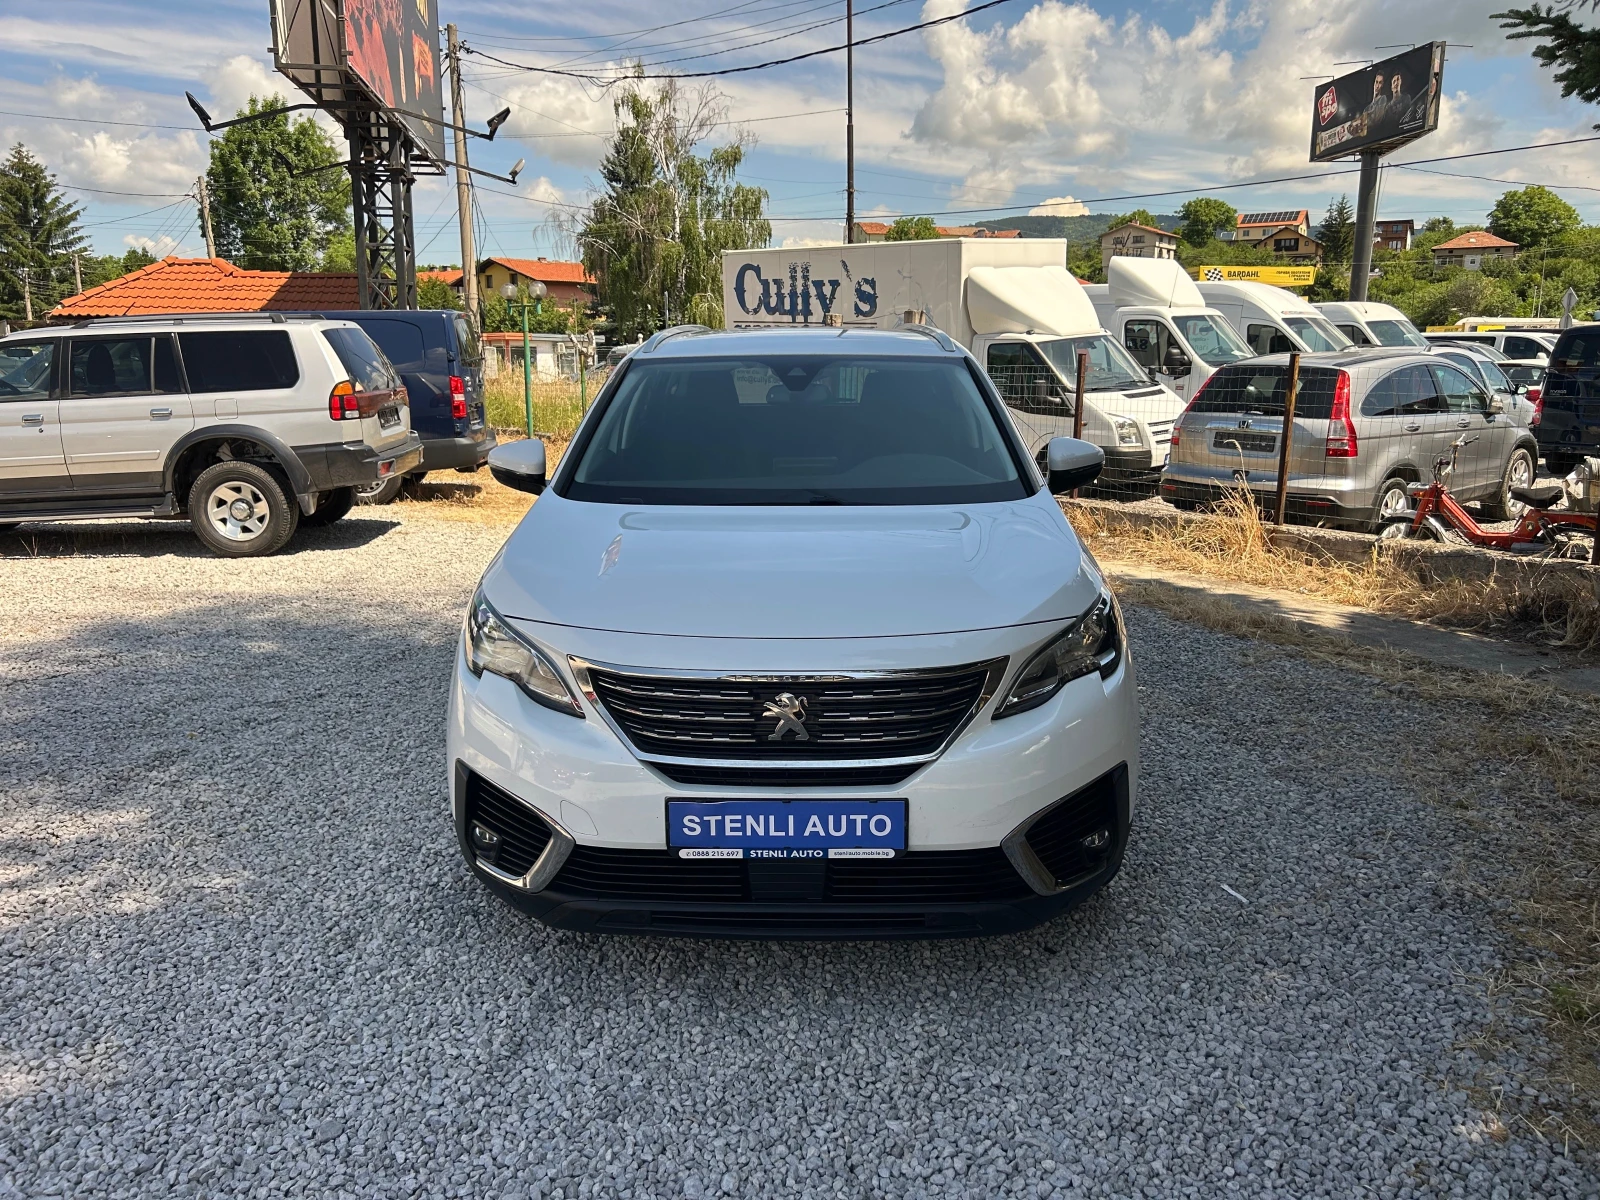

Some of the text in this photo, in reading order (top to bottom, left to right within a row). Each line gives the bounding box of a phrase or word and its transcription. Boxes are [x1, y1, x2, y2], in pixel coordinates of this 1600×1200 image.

[1227, 270, 1260, 278] BARDAHL
[682, 814, 892, 837] STENLI AUTO
[749, 849, 824, 858] STENLI AUTO
